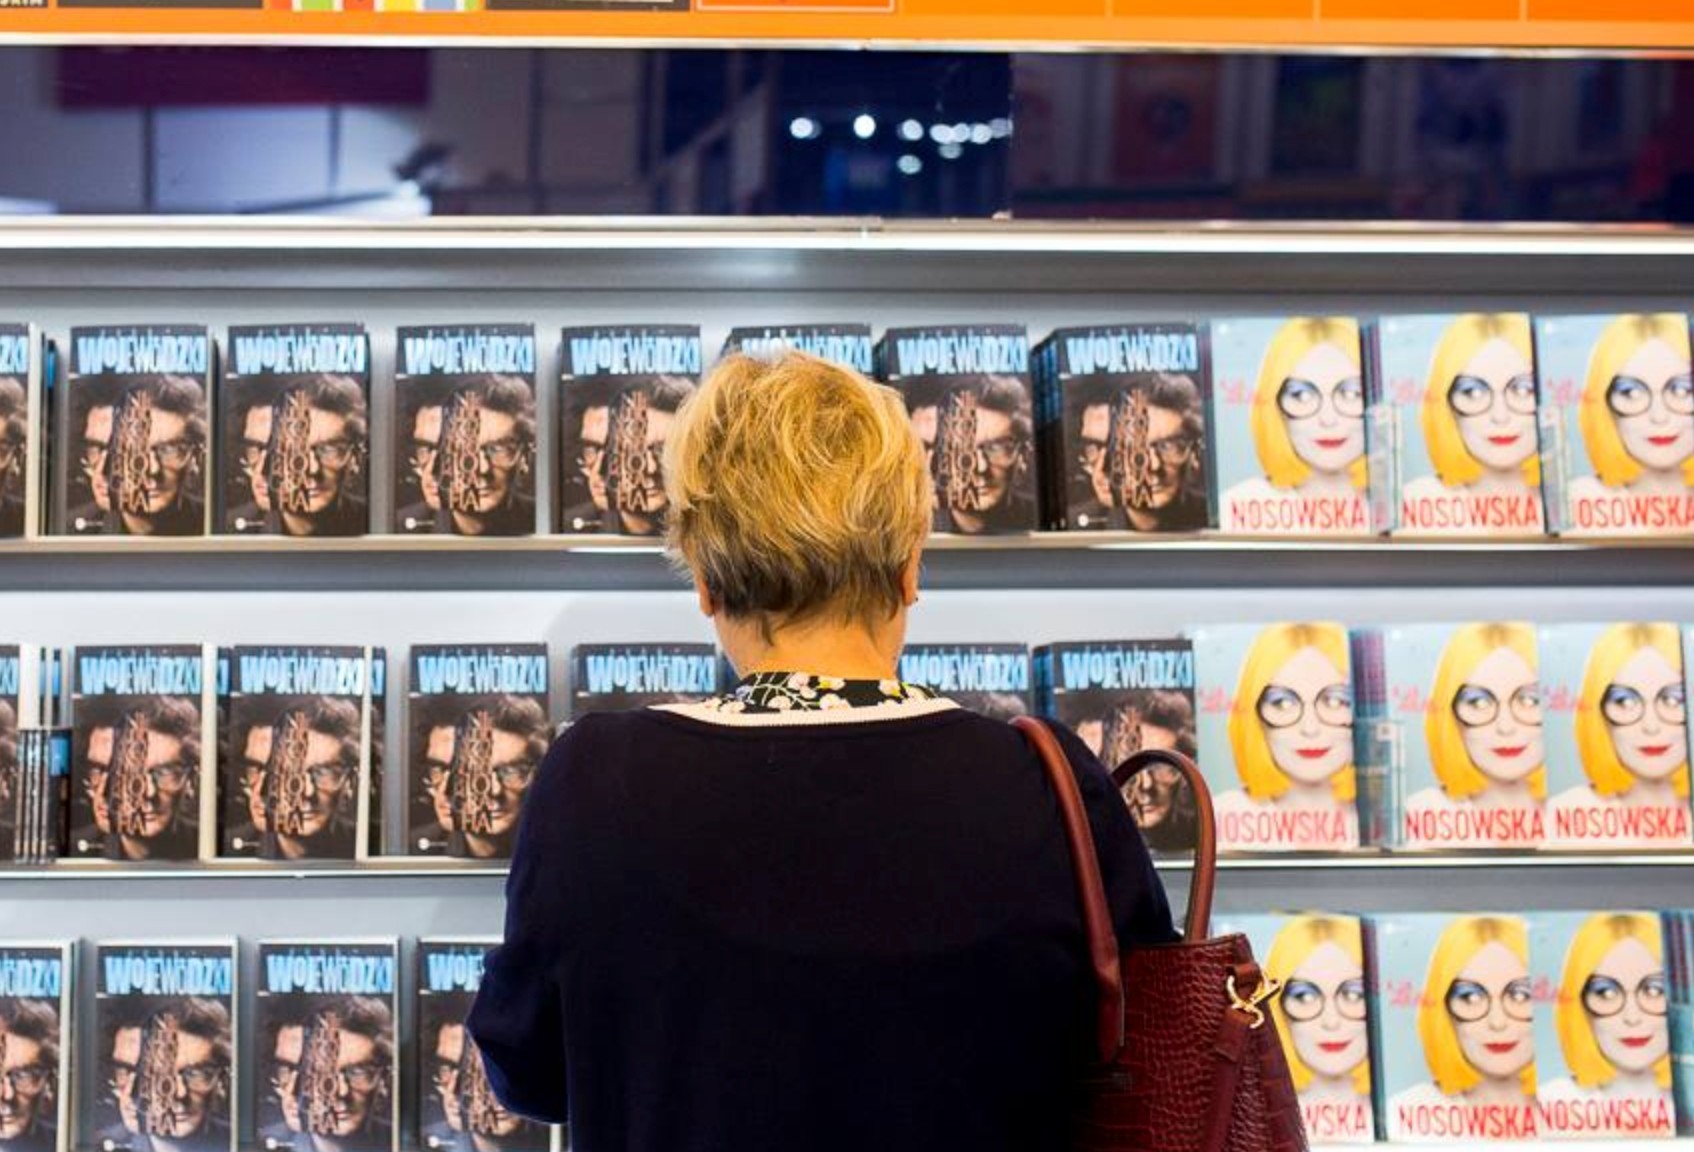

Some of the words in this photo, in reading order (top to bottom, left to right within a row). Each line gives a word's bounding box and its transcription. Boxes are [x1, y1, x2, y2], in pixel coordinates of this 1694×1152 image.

[1231, 498, 1366, 529] NOSOWSKA
[1403, 496, 1538, 527] NOSOWSKA
[1406, 807, 1545, 841] NOSOWSKA
[1556, 807, 1687, 839] NOSOWSKA
[1399, 1105, 1537, 1138] NOSOWSKA
